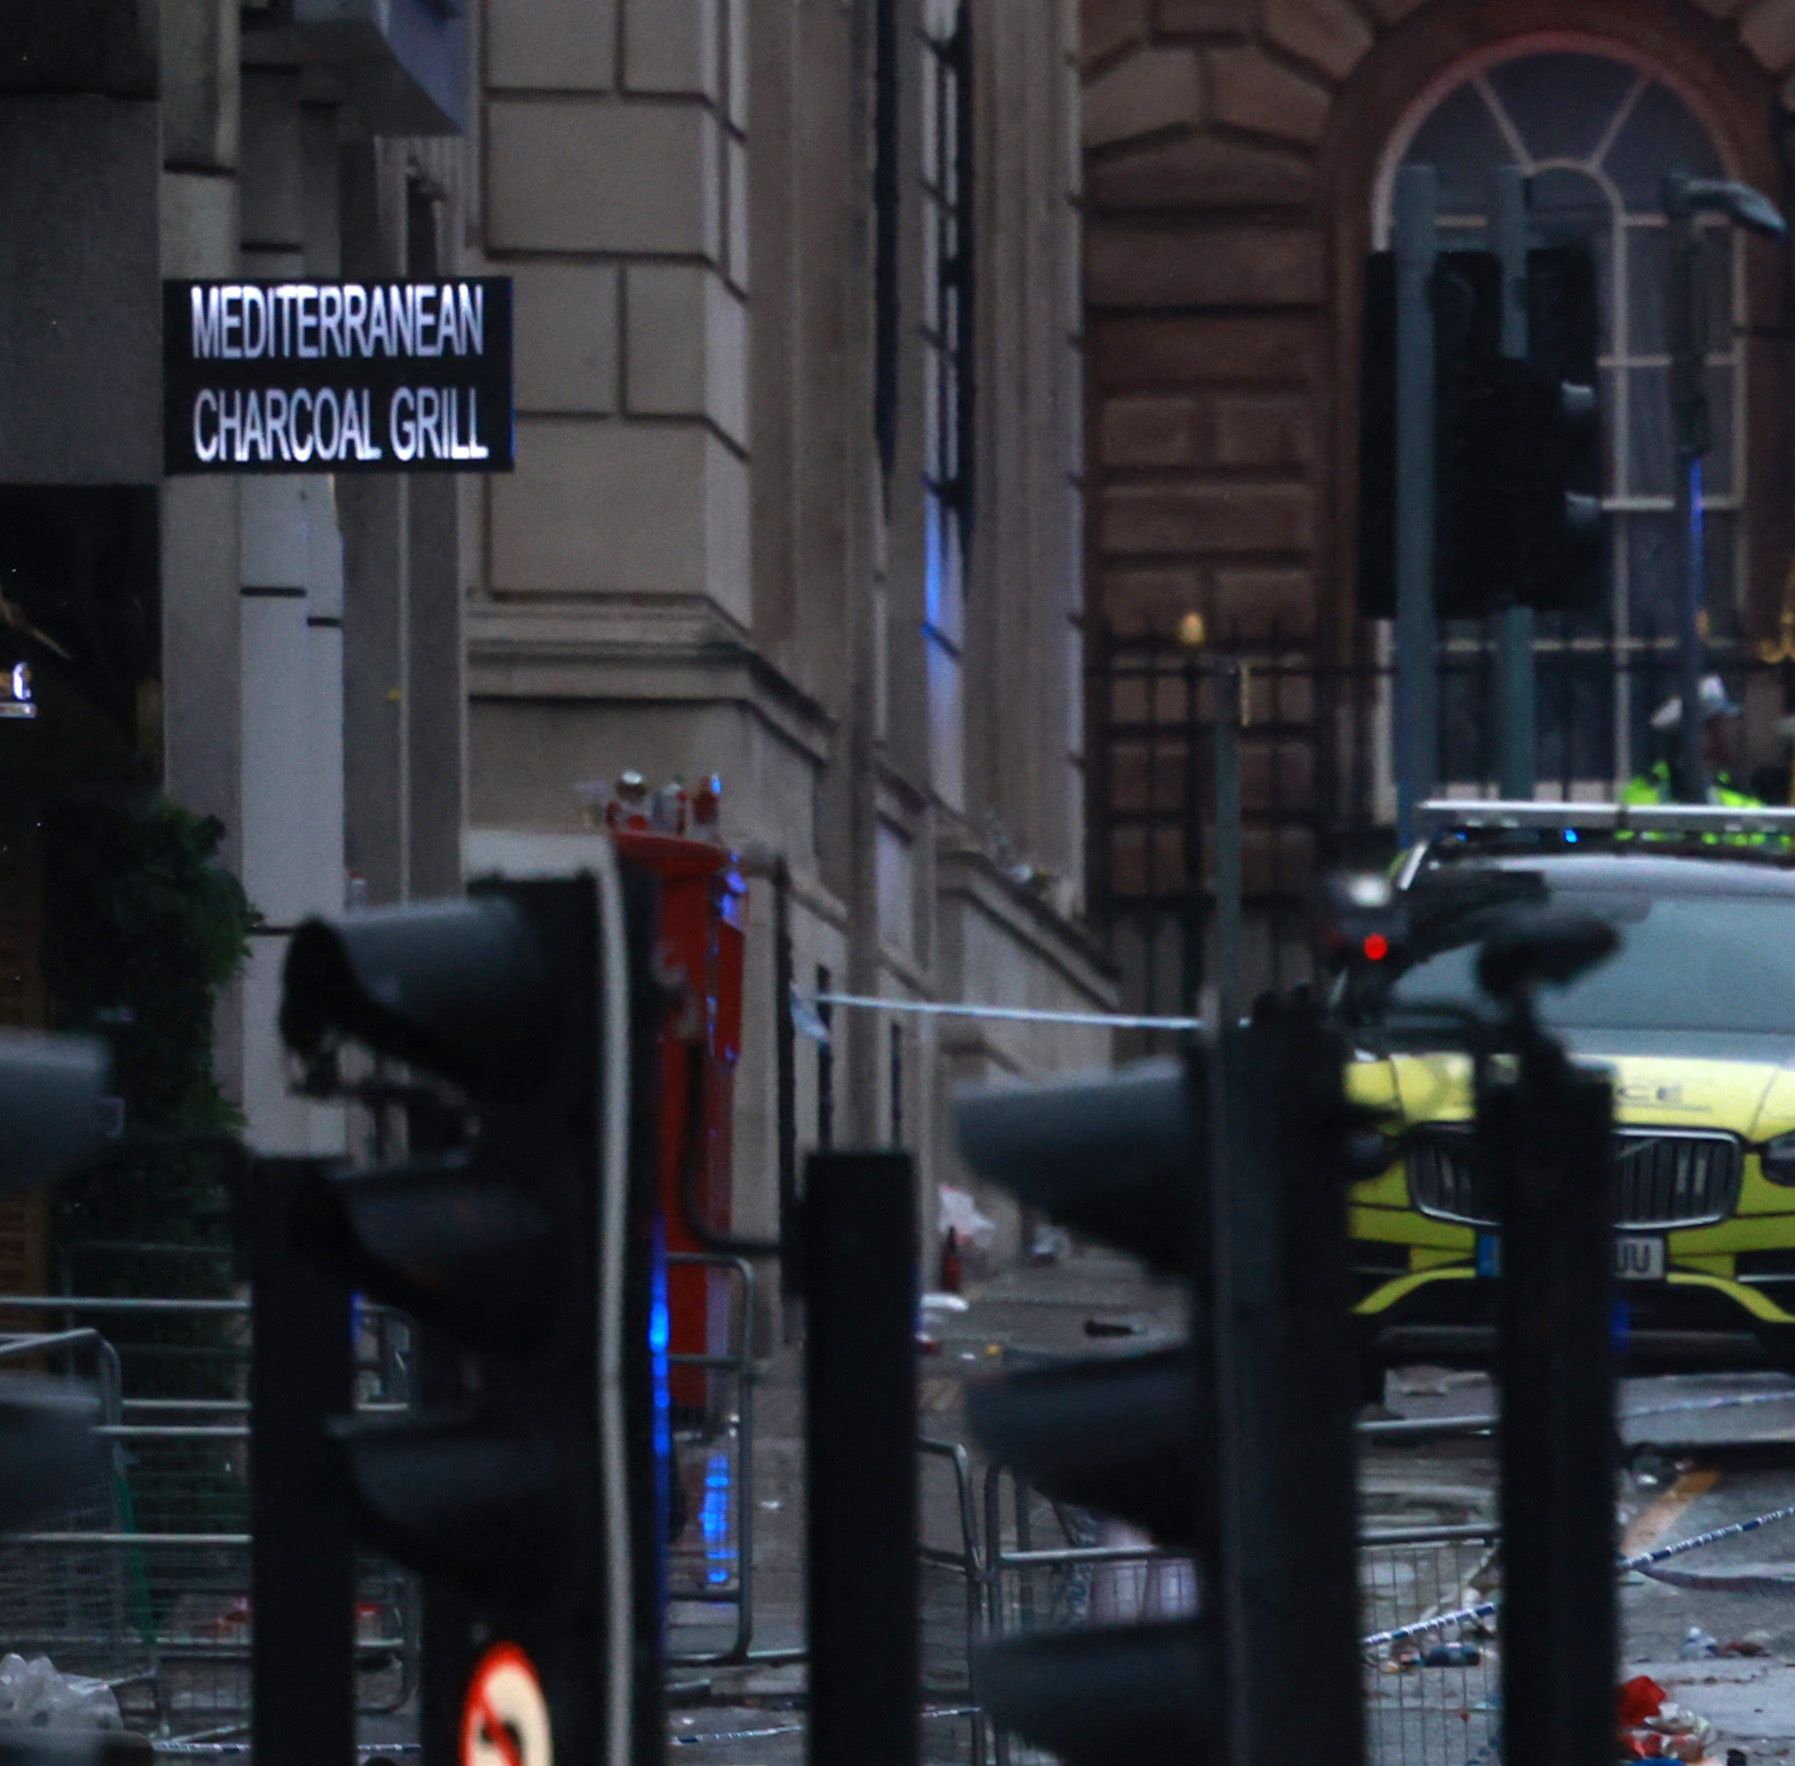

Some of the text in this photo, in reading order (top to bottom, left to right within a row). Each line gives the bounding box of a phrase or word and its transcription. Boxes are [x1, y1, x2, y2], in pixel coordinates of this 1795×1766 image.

[190, 284, 485, 360] MEDITERRANEAN
[192, 386, 489, 463] CHARCOAL GRILL
